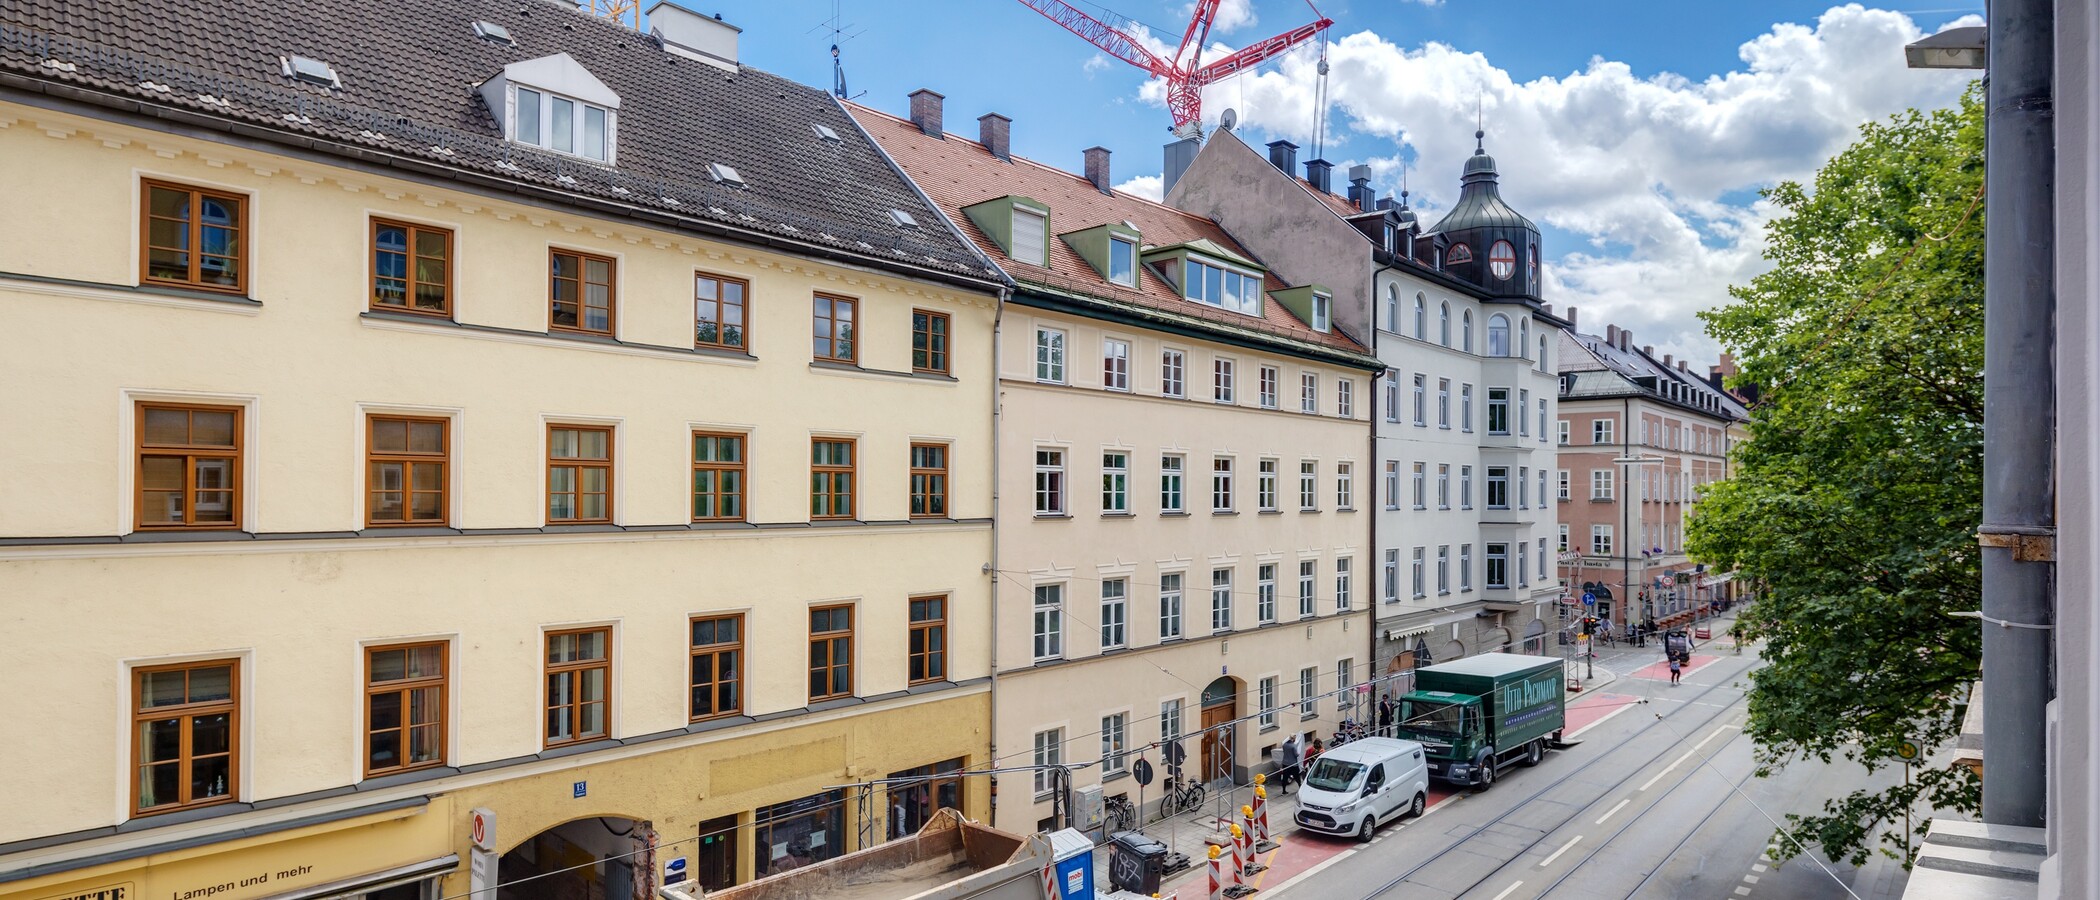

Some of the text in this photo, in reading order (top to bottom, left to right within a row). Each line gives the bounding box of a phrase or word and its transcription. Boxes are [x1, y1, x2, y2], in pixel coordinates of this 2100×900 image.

[576, 782, 585, 791] 13
[1069, 870, 1083, 881] mobi
[173, 865, 313, 900] Lampen und mehr
